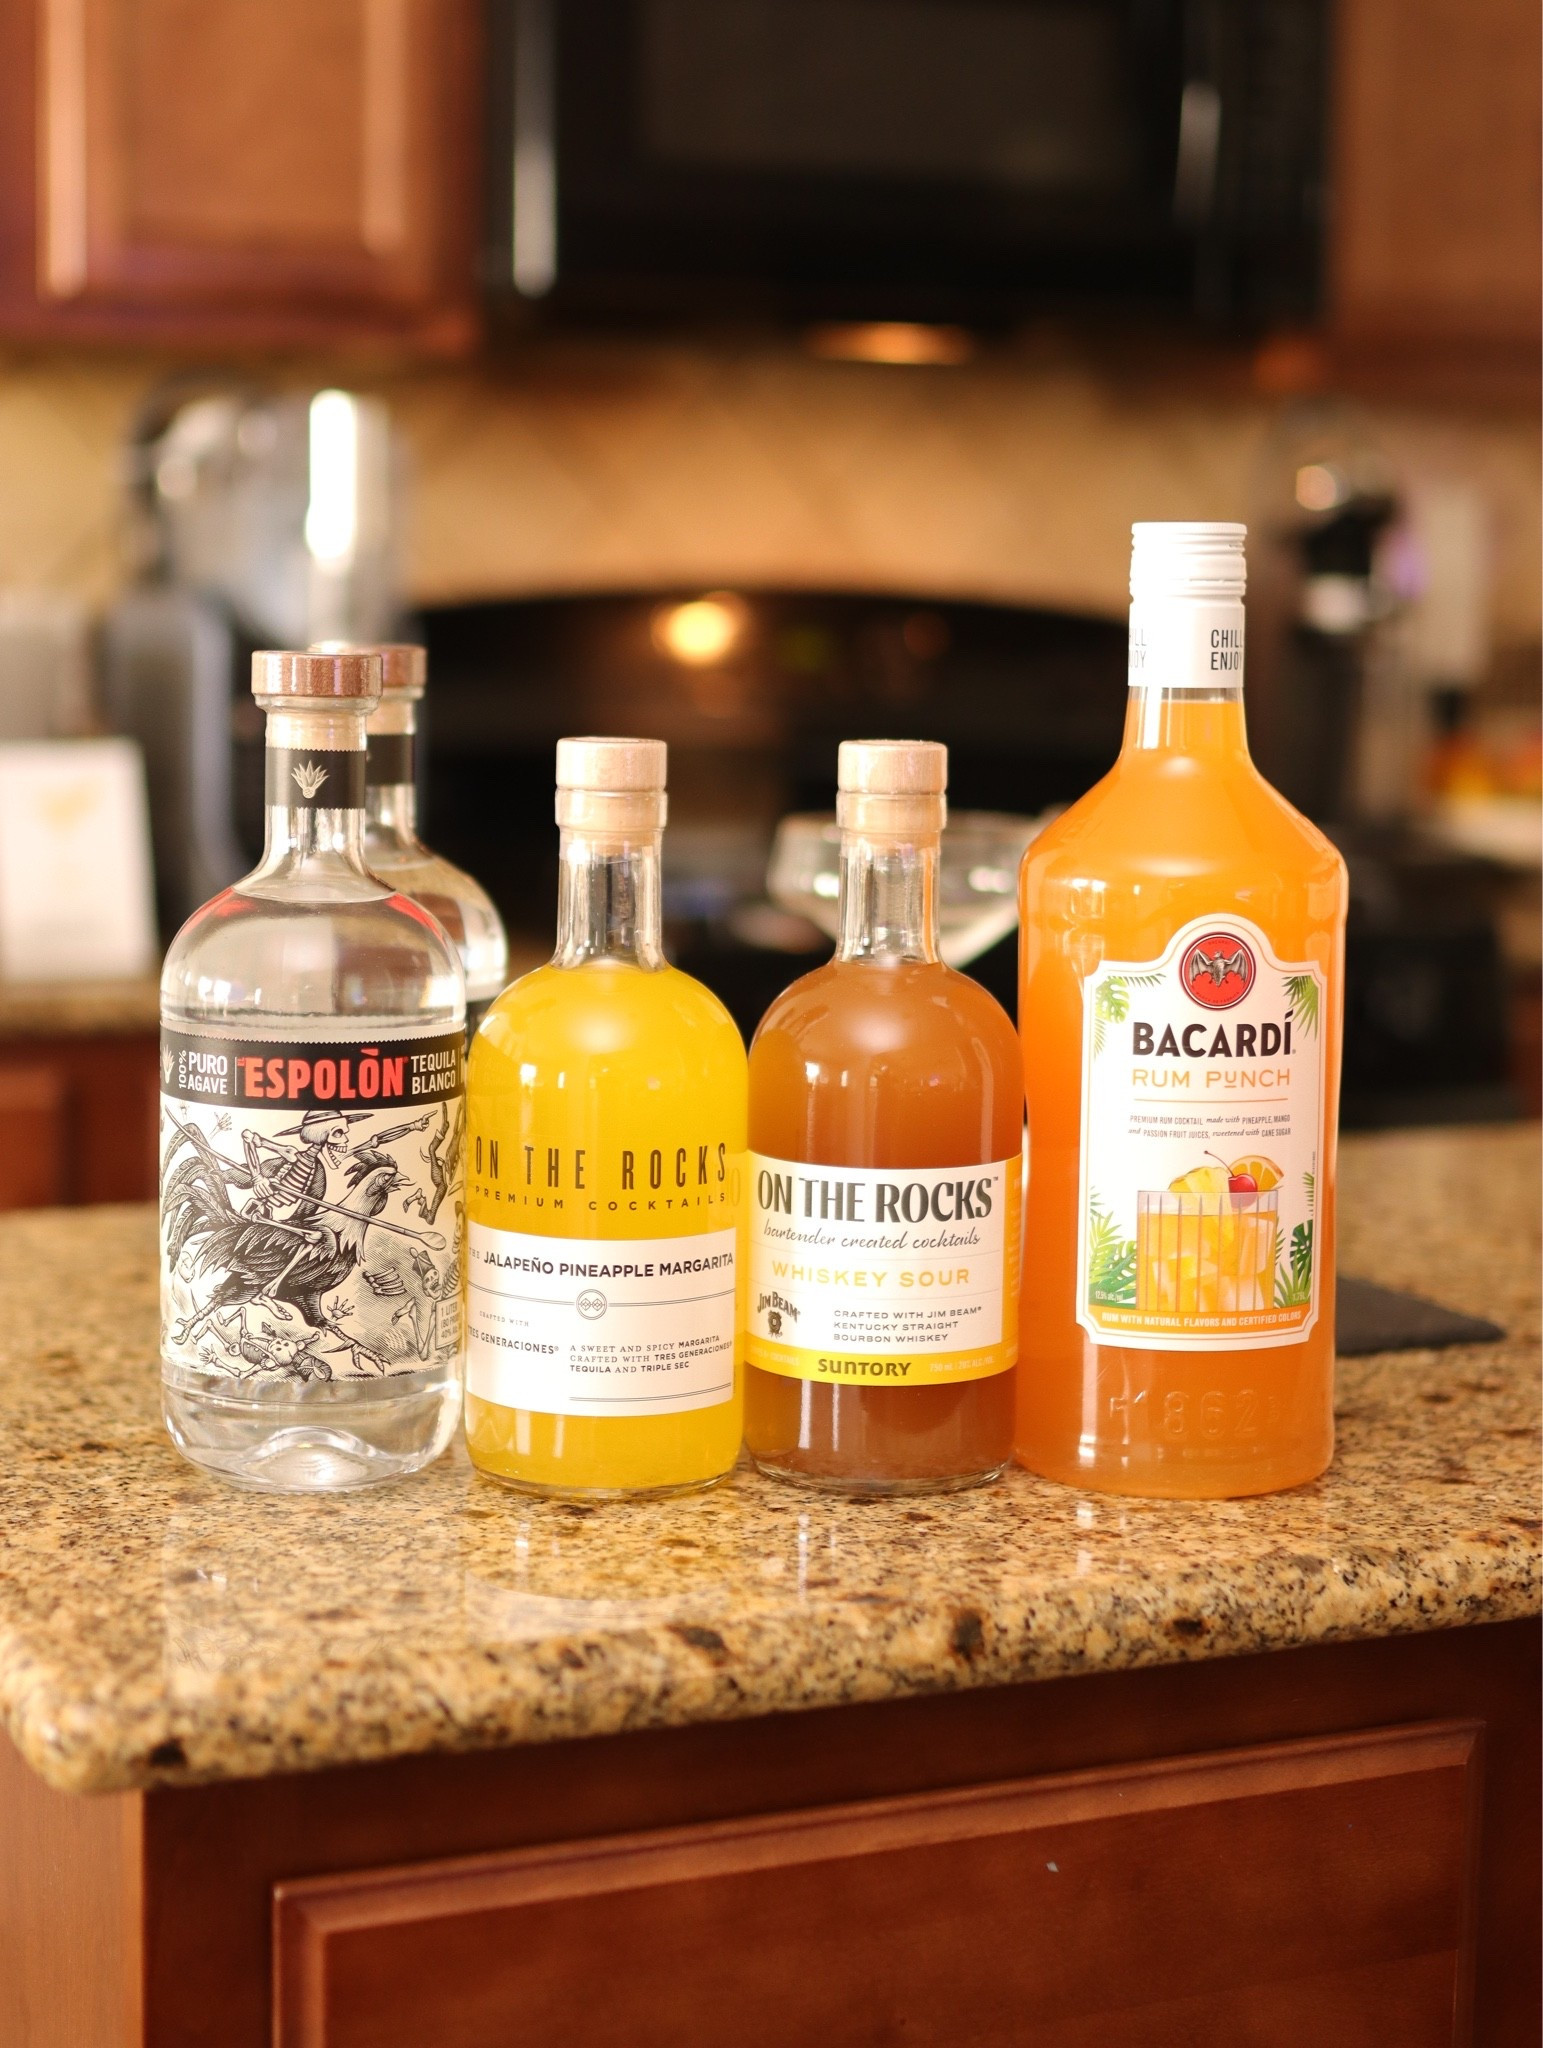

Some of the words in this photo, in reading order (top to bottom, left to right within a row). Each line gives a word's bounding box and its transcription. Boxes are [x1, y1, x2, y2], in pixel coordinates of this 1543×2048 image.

[1132, 1009, 1293, 1058] BACARDÍ
[178, 1050, 187, 1089] 100%
[188, 1051, 228, 1076] PURO
[410, 1049, 456, 1074] TEQUILA
[187, 1074, 228, 1095] AGAVE
[411, 1070, 456, 1095] BLANCO
[1132, 1069, 1190, 1088] RUM
[1206, 1068, 1290, 1089] PUNCH
[1130, 1115, 1158, 1124] PREMIUM
[1160, 1116, 1173, 1125] RUM
[1174, 1117, 1203, 1126] COCKTAIL
[1273, 1114, 1291, 1123] MANGO
[1143, 1129, 1168, 1138] PASSION
[1170, 1130, 1187, 1139] FRUIT
[1188, 1131, 1210, 1140] JUICES,
[1212, 1129, 1245, 1137] sweetened
[1245, 1128, 1260, 1136] with
[1261, 1129, 1275, 1138] CANE
[1276, 1128, 1291, 1137] SUGAR
[476, 1135, 498, 1179] ON
[524, 1146, 586, 1189] THE
[622, 1142, 726, 1190] ROCKS
[476, 1185, 563, 1209] PREMIUM
[588, 1192, 725, 1211] COCKTAILS
[757, 1170, 793, 1215] ON
[798, 1177, 866, 1223] THE
[763, 1218, 836, 1245] bartender
[841, 1231, 908, 1249] created
[912, 1227, 981, 1249] cocktails
[484, 1251, 554, 1275] JALAPEÑO
[559, 1262, 654, 1278] PINEAPPLE
[659, 1252, 734, 1277] MARGARITA
[772, 1260, 888, 1288] WHISKEY
[900, 1268, 970, 1288] SOUR
[757, 1293, 771, 1314] JIM
[479, 1310, 506, 1323] CRAFTED
[509, 1318, 529, 1327] WITH
[834, 1310, 889, 1319] CRAFTED
[893, 1311, 924, 1319] WITH
[927, 1310, 946, 1319] JIM
[1120, 1313, 1142, 1325] WITH
[1144, 1316, 1181, 1327] NATURAL
[1183, 1317, 1220, 1328] FLAVORS
[1221, 1317, 1237, 1327] AND
[1239, 1314, 1277, 1326] CERTIFIED
[1278, 1310, 1302, 1323] COLORS
[834, 1321, 898, 1331] KENTUCKY
[902, 1320, 959, 1331] STRAIGHT
[570, 1344, 577, 1352] A
[581, 1345, 616, 1353] SWEET
[620, 1345, 642, 1353] AND
[646, 1342, 675, 1352] SPICY
[678, 1335, 720, 1349] MARGARITA
[834, 1333, 891, 1343] BOURBON
[896, 1333, 949, 1343] WHISKEY
[570, 1355, 618, 1363] CRAFTED
[623, 1355, 650, 1363] WITH
[655, 1353, 676, 1362] TRES
[570, 1364, 611, 1373] TEQUILA
[615, 1365, 637, 1373] AND
[641, 1364, 671, 1373] TRIPLE
[675, 1361, 690, 1370] SEC
